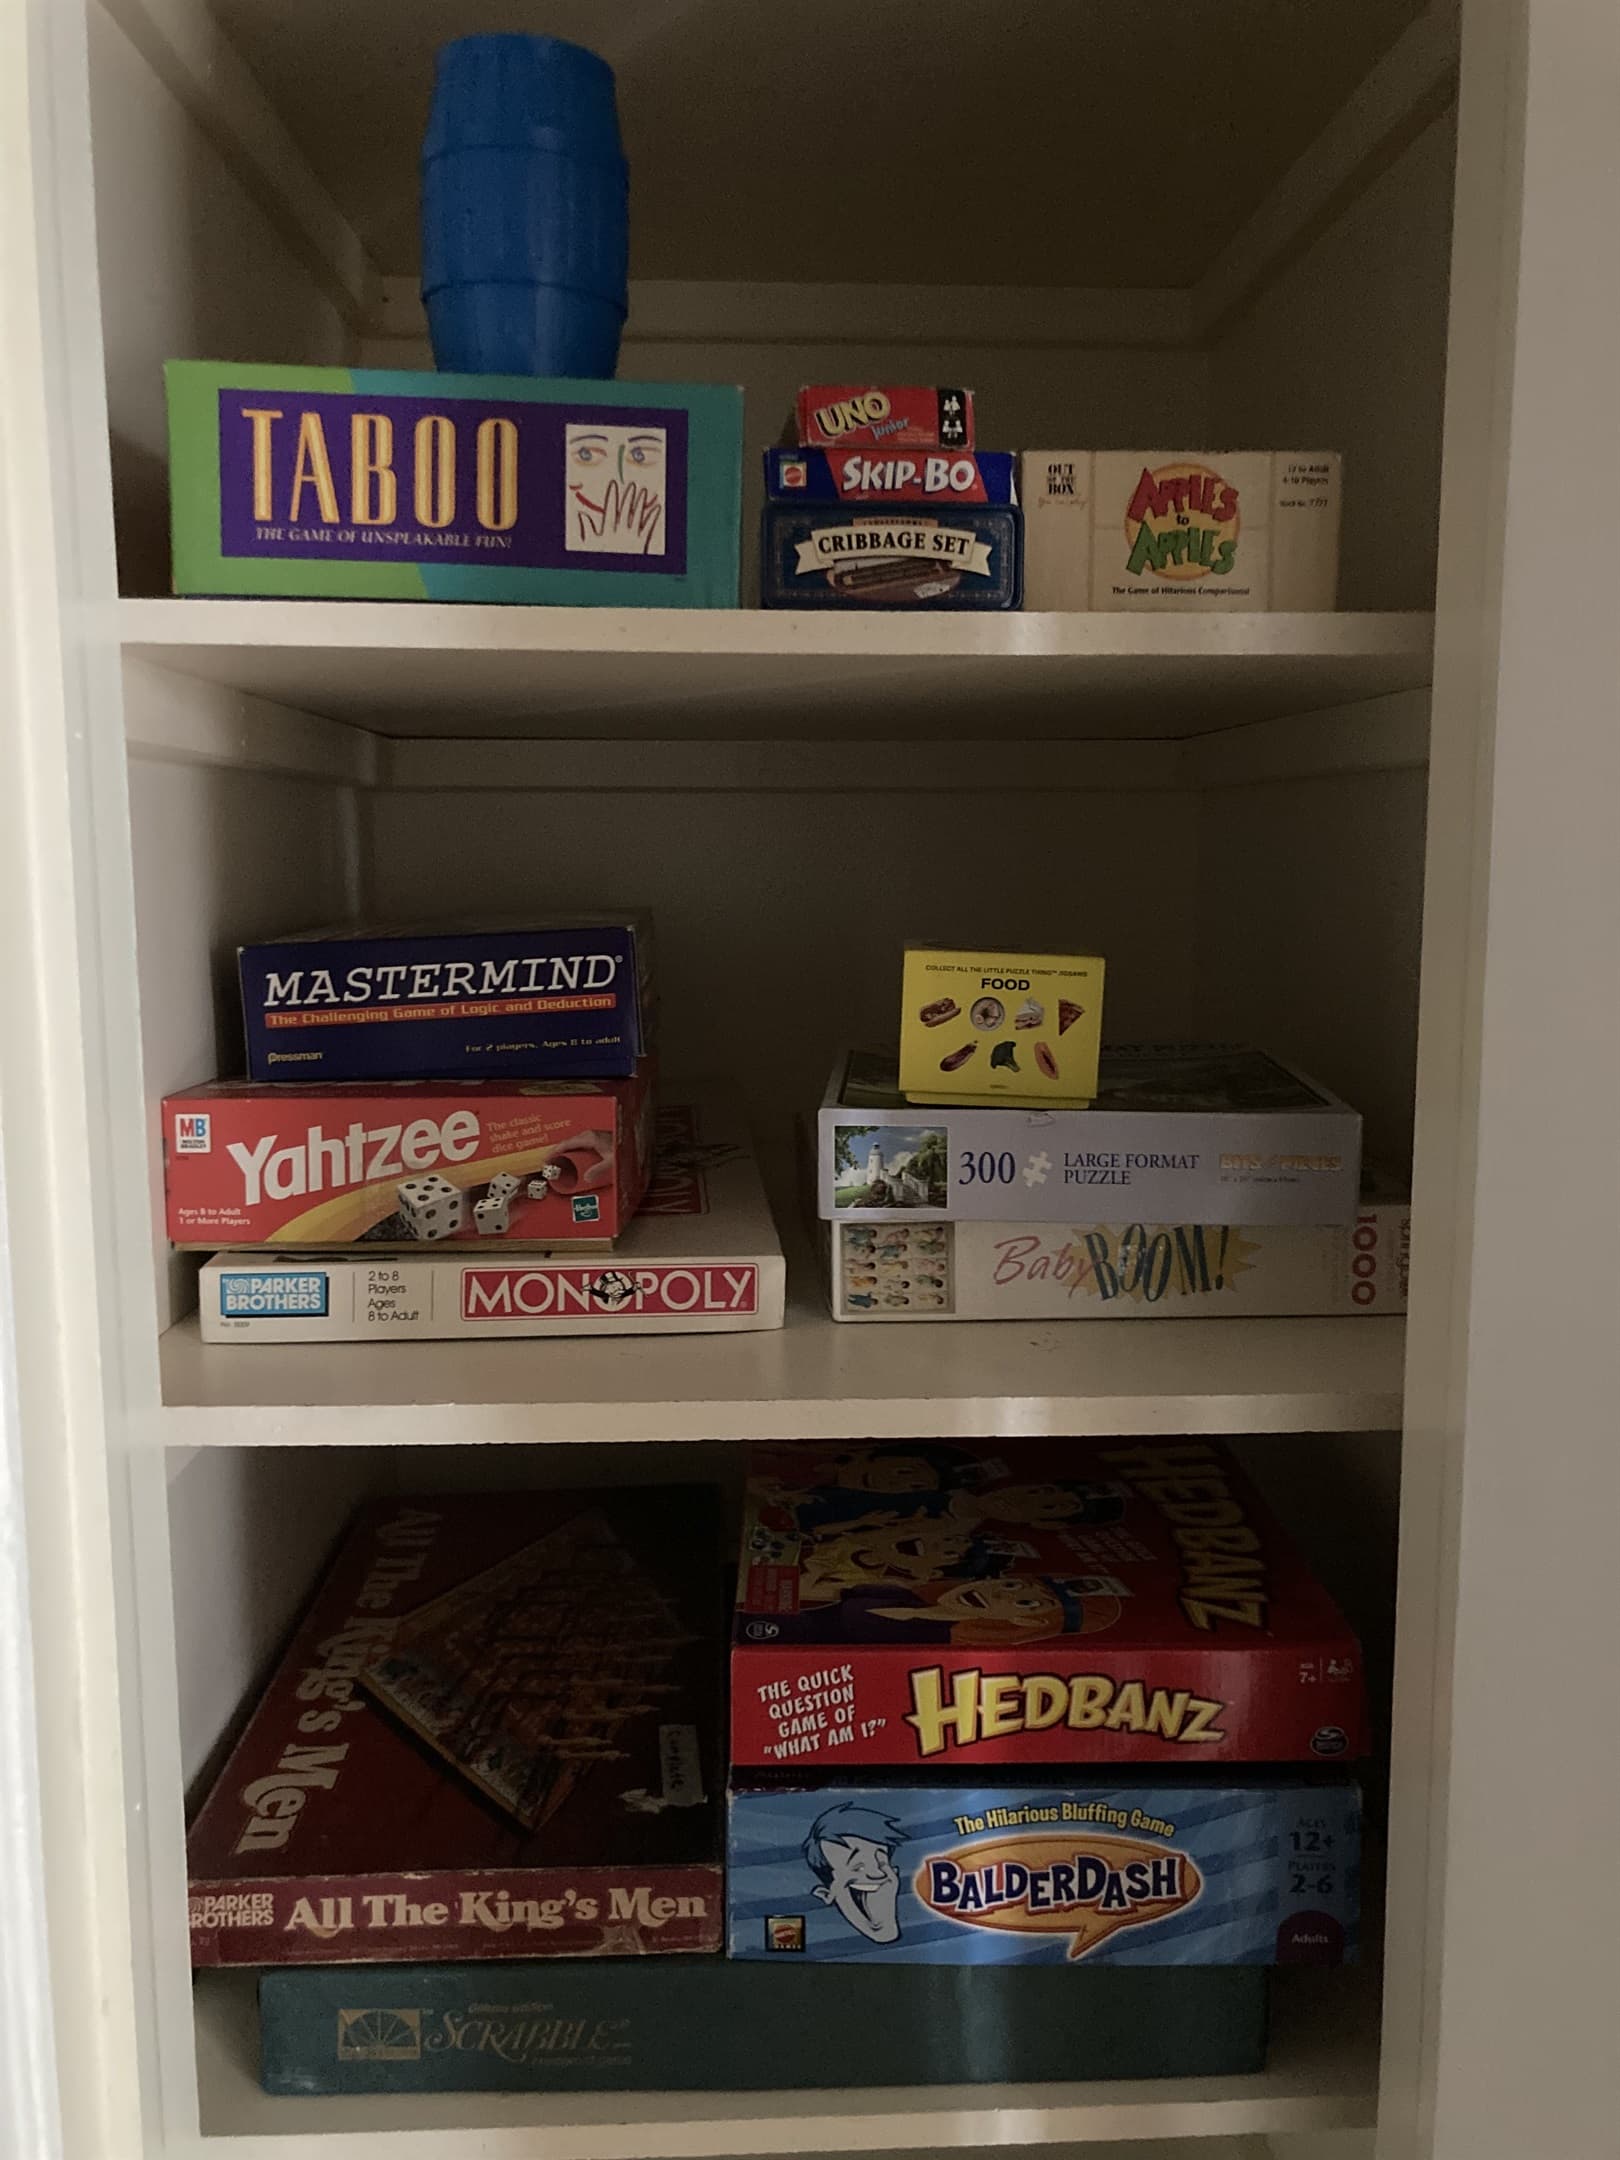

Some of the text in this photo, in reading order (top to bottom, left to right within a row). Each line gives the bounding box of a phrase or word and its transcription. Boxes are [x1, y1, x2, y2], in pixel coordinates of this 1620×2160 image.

[814, 390, 891, 439] UNO
[241, 408, 520, 532] TABOO
[841, 456, 977, 494] SKIP-BO
[1048, 463, 1075, 475] OUT
[1048, 483, 1075, 495] BOX
[1176, 514, 1190, 526] to
[255, 527, 284, 542] THE
[287, 528, 332, 543] GAME
[818, 531, 970, 556] CRIBBAGE SET
[980, 977, 1031, 991] FOOD
[270, 996, 612, 1026] The Challenging Game of Logic and Deduction
[465, 1044, 482, 1054] For
[485, 1044, 494, 1052] 2
[542, 1039, 568, 1049] Ages
[580, 1038, 593, 1046] to
[595, 1035, 621, 1045] adult
[179, 1117, 207, 1138] MB
[485, 1112, 543, 1132] The classic
[489, 1119, 572, 1143] shake and score
[226, 1109, 481, 1207] Yahtzee
[491, 1143, 514, 1154] dice
[958, 1150, 1017, 1186] 300
[1063, 1152, 1201, 1171] LARGE FORMAT
[1063, 1169, 1133, 1187] PUZZLE
[178, 1207, 199, 1218] Ages
[220, 1217, 251, 1227] Players
[993, 1236, 1096, 1298] Baby
[1084, 1223, 1231, 1302] BOOM!
[1351, 1213, 1380, 1306] 1000
[250, 1278, 321, 1294] PARKER
[368, 1270, 400, 1282] 2 to 8
[368, 1283, 407, 1296] Players
[467, 1269, 753, 1317] MONOPOLY
[225, 1294, 322, 1311] BROTHERS
[367, 1298, 396, 1311] Ages
[367, 1310, 419, 1322] 8 to Adult
[1101, 1443, 1269, 1632] HEDBANZ
[234, 1507, 443, 1854] All The King's Men
[757, 1664, 854, 1703] THE QUICK
[1299, 1671, 1317, 1685] 7+
[768, 1684, 856, 1721] QUESTION
[909, 1665, 1226, 1757] HEDBANZ
[778, 1704, 857, 1740] GAME OF
[763, 1718, 887, 1762] "WHAT AM I?"
[954, 1802, 1177, 1838] The Hilarious Bluffing Game
[1289, 1831, 1336, 1852] 12+
[931, 1856, 1177, 1910] BALDERDASH
[1289, 1873, 1334, 1894] 2-6
[204, 1893, 274, 1912] PARKER
[284, 1885, 709, 1938] All The King's Men
[190, 1910, 275, 1929] ROTHERS
[1290, 1933, 1330, 1945] Adults
[423, 2010, 611, 2064] SCRABBLE
